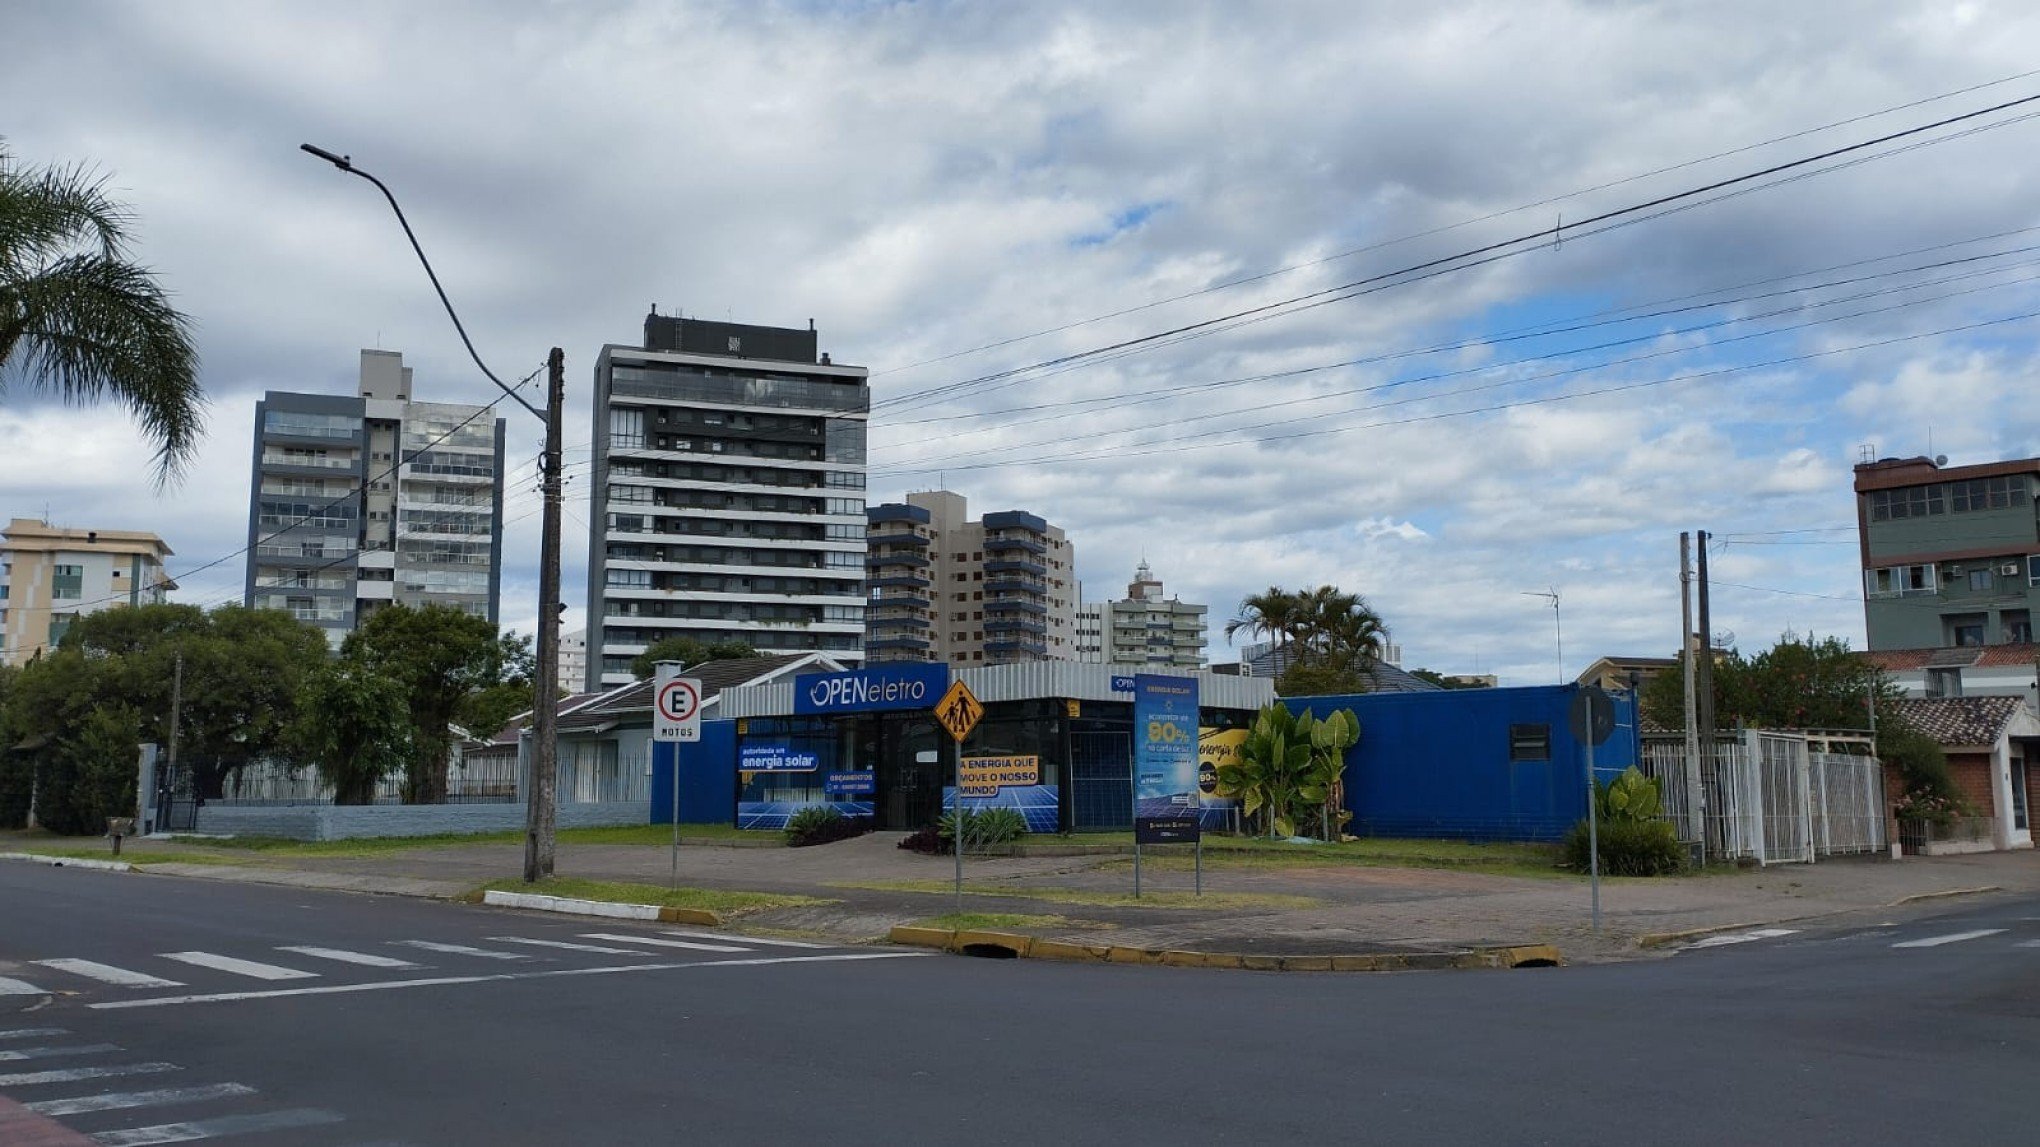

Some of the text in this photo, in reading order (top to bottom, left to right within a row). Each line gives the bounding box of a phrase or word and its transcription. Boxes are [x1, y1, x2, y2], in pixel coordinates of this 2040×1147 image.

[672, 691, 685, 713] E
[662, 728, 692, 736] MOTOS
[742, 754, 814, 769] energia solar
[968, 760, 1011, 768] ENERGIA
[1014, 758, 1034, 767] QUE
[960, 771, 1037, 782] MOVE O NOSSO
[960, 785, 997, 794] MUNDO
